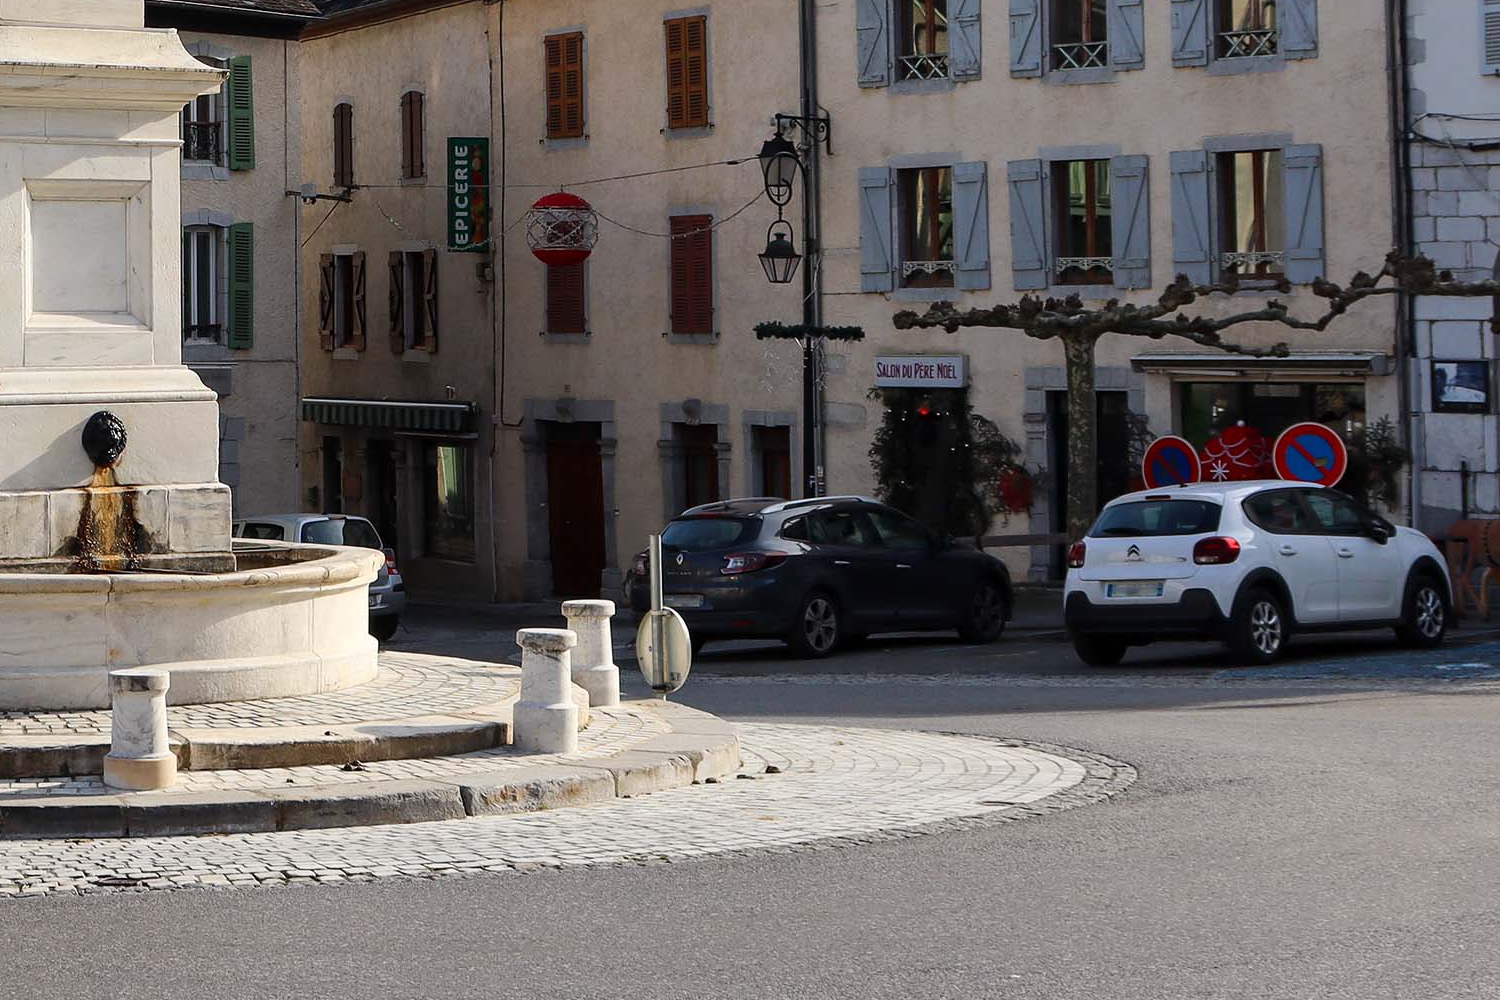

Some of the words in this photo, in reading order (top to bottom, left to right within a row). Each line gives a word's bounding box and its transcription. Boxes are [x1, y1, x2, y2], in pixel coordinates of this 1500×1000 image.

[454, 145, 469, 245] EPICERIE
[876, 362, 900, 378] SALON
[902, 365, 913, 378] DU
[914, 361, 935, 379] PÈRE
[937, 362, 957, 379] NOËL
